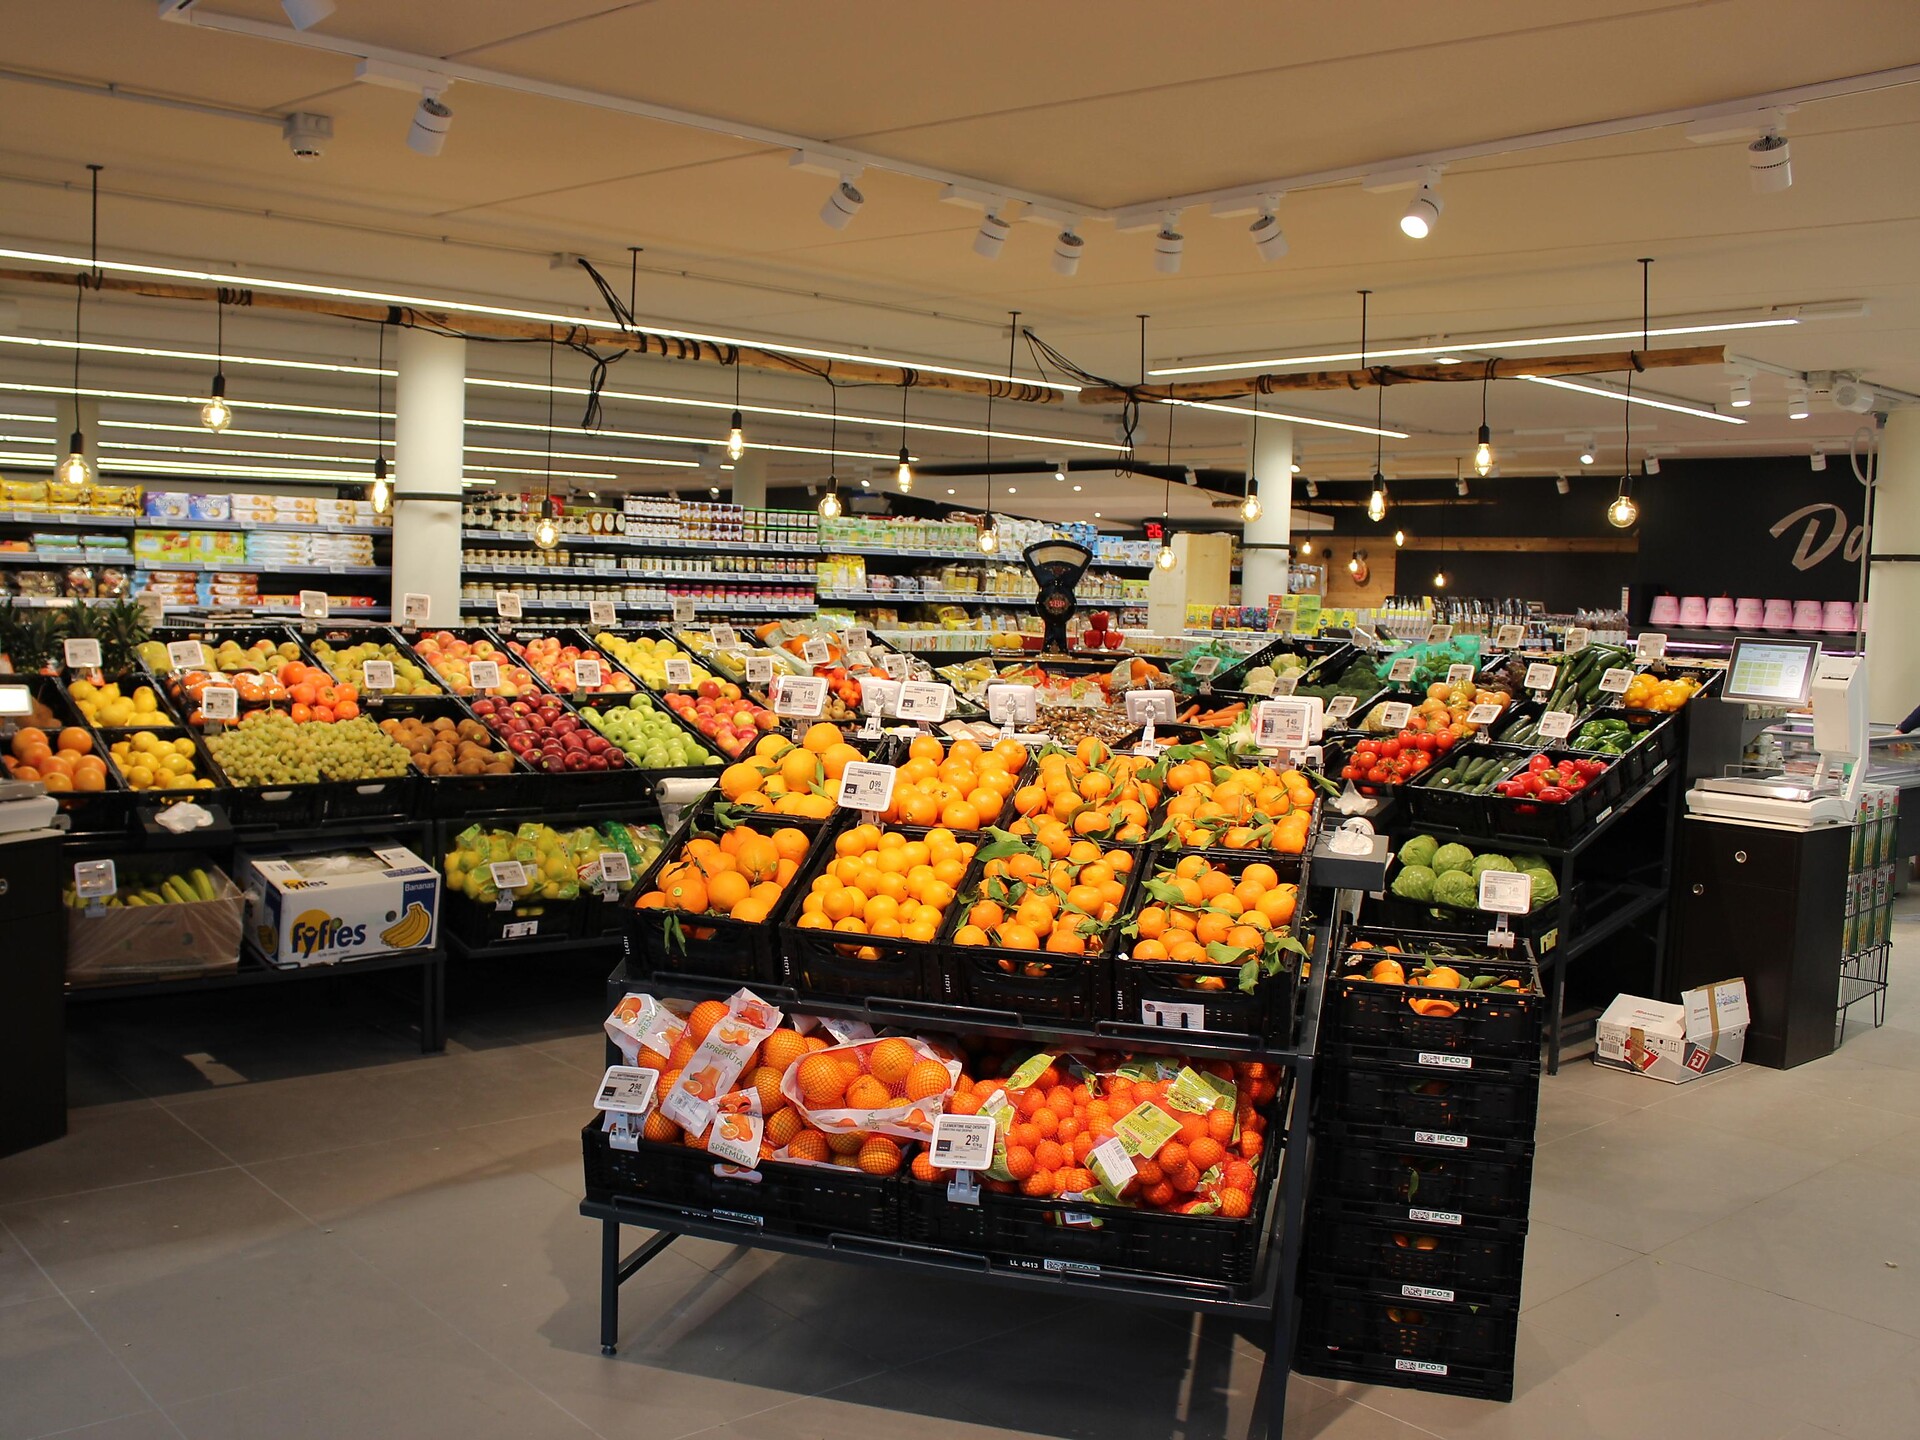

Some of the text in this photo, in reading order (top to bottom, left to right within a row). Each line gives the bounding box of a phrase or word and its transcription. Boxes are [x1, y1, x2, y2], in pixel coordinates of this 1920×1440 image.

[1147, 523, 1163, 538] 26
[404, 881, 435, 892] Bananas
[704, 1041, 743, 1067] SPREMUTA
[1442, 1056, 1461, 1064] IFCO
[1125, 1120, 1157, 1146] CLEMENTINE
[710, 1142, 752, 1166] SPREMUTA
[1431, 1212, 1450, 1220] IFCO
[1009, 1259, 1019, 1267] LL
[1424, 1289, 1443, 1297] IFCO
[1418, 1363, 1437, 1371] IFCO
